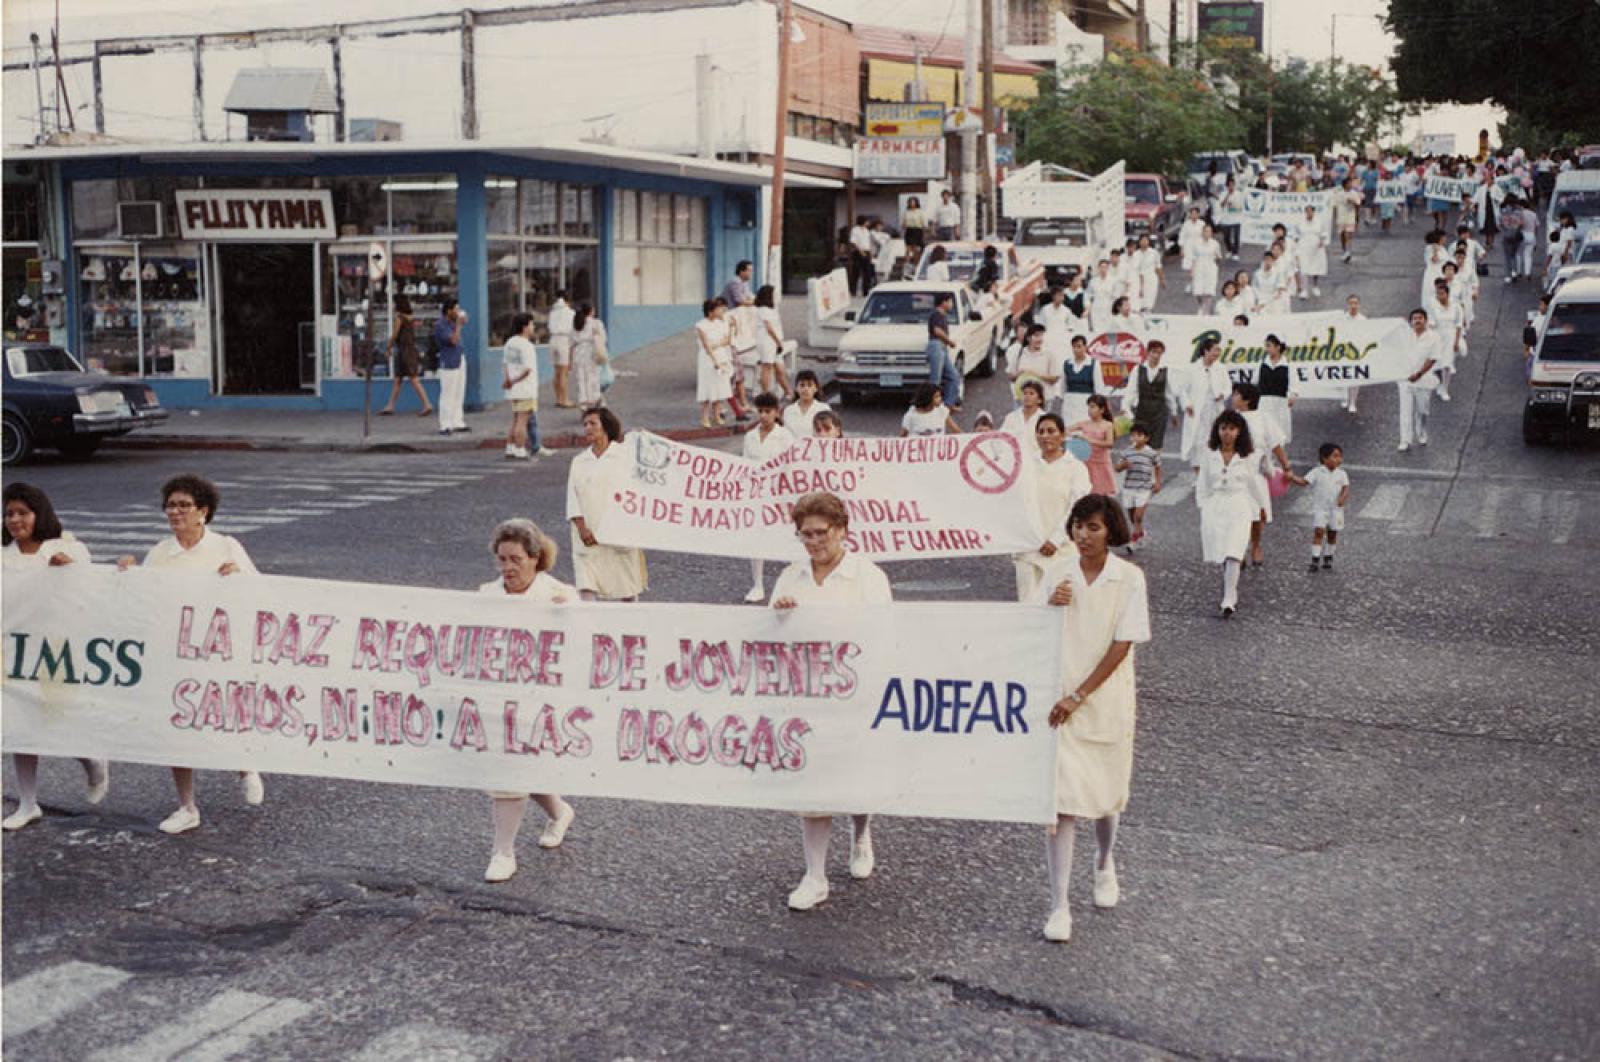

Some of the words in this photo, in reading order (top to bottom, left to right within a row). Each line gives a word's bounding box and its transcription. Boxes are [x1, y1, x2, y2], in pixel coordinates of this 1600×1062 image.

[859, 140, 940, 154] FARMACIA
[184, 199, 327, 230] FUJIYAMA
[1190, 326, 1379, 364] Biennidos
[818, 440, 830, 463] Y
[831, 437, 868, 463] UNA
[871, 437, 960, 464] JUVENTUD
[684, 474, 744, 501] LIBRE
[652, 498, 684, 524] DE
[690, 506, 756, 530] MAYO
[841, 499, 930, 525] NDIAL
[846, 530, 886, 553] SIN
[7, 632, 146, 687] IMSS
[176, 606, 233, 661] LA
[251, 610, 336, 667] PAZ
[352, 617, 565, 687] REQUIERE
[589, 634, 647, 691] DE
[664, 638, 862, 698] JOVENES
[870, 677, 1029, 734] ADEFAR
[450, 698, 488, 752] A
[503, 700, 594, 758] LAS
[616, 707, 812, 772] DROGAS
